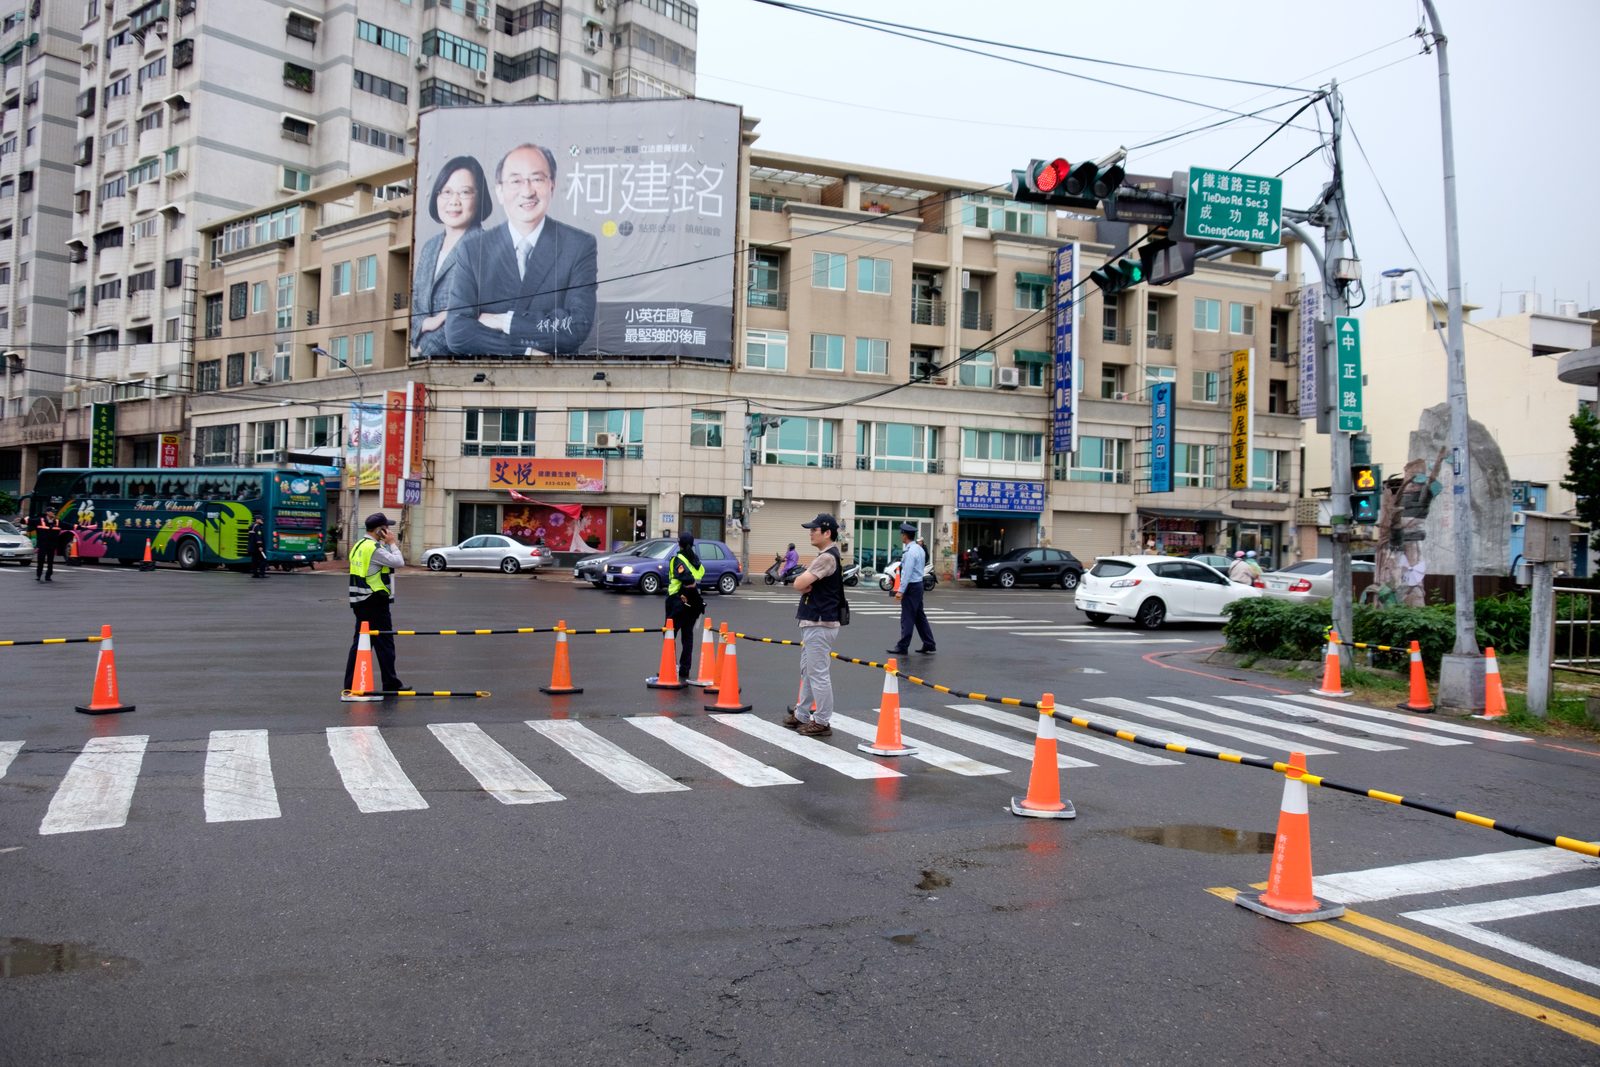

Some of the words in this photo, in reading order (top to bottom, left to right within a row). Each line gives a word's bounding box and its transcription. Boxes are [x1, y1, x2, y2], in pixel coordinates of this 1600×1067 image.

[566, 160, 724, 217] 柯建銘
[1202, 172, 1271, 195] 鐵道路三段
[1202, 191, 1230, 204] TieDao
[1200, 204, 1269, 226] 成功路
[1198, 223, 1250, 241] ChengGong
[625, 308, 694, 324] 小英在國會
[625, 328, 707, 345] 最堅強的後盾
[1342, 333, 1357, 407] 中正路
[1156, 402, 1166, 458] 速力印
[1233, 366, 1248, 484] 美樂屋童裝
[492, 461, 536, 486] 艾悅
[405, 489, 420, 503] 999
